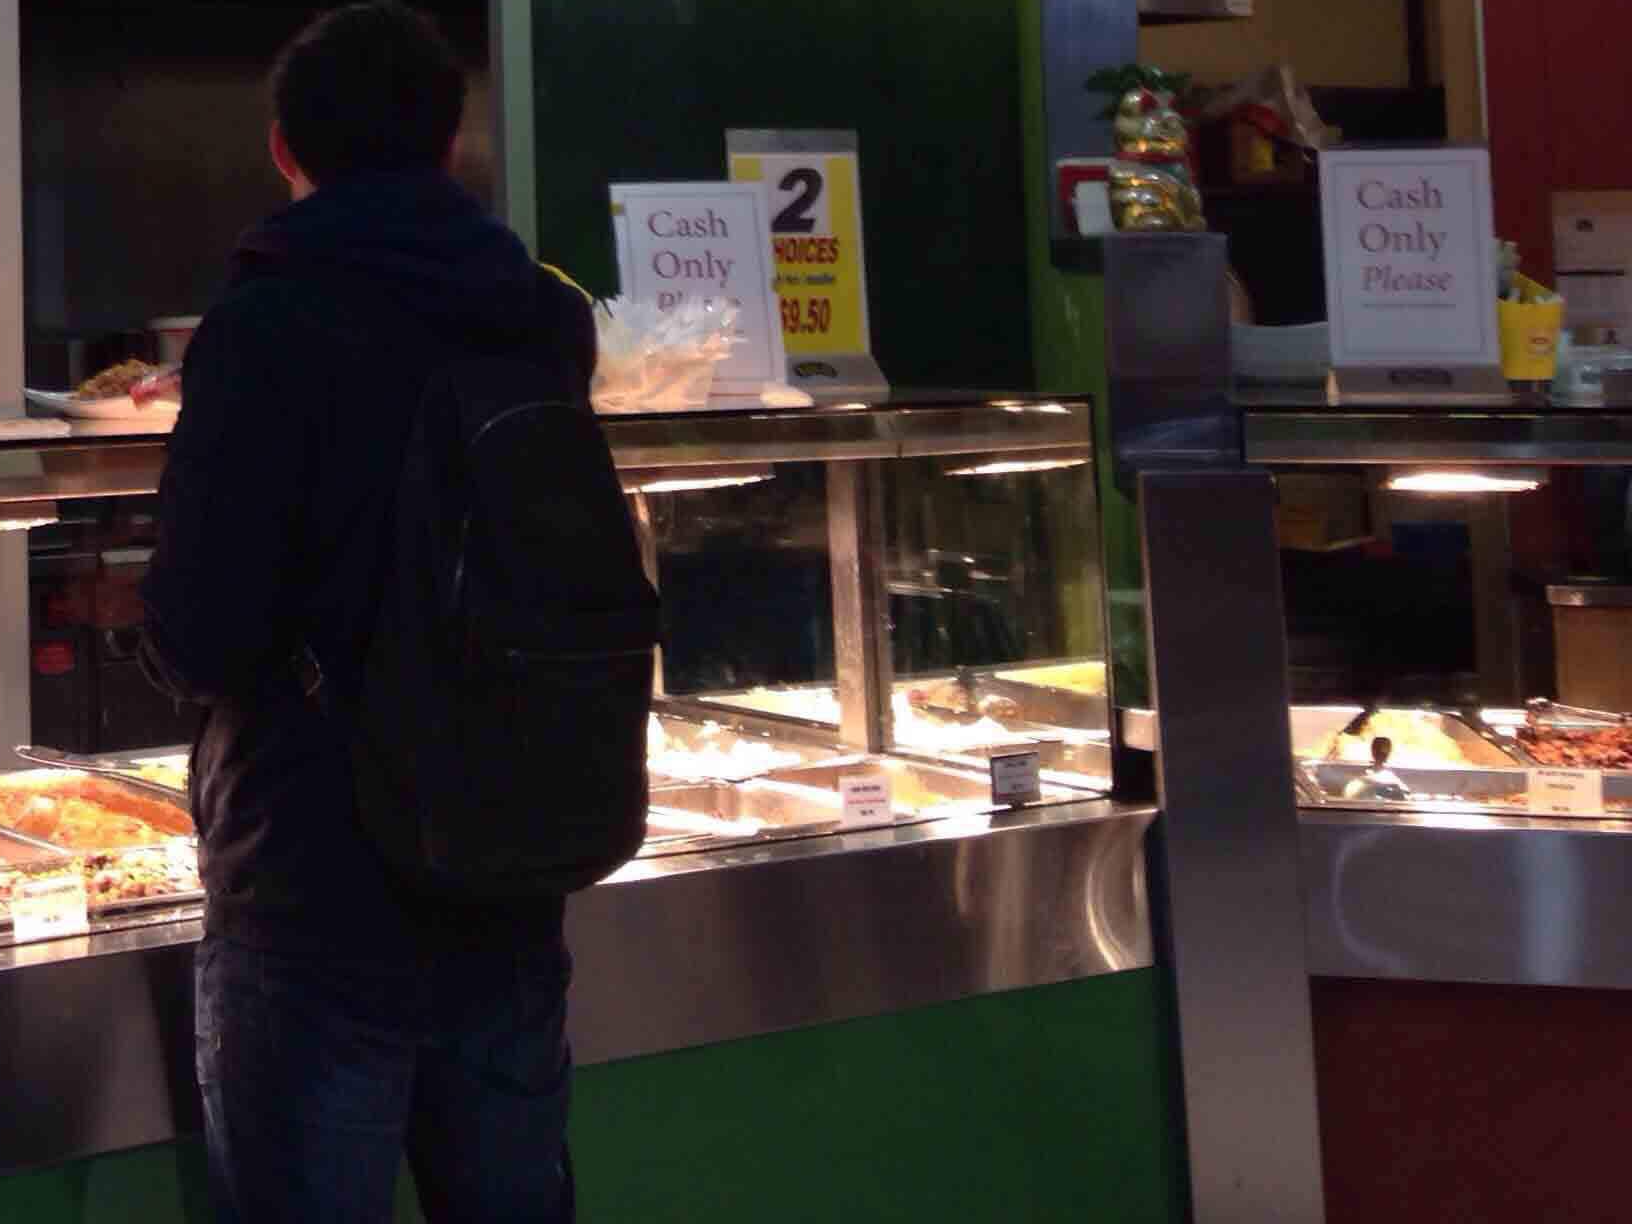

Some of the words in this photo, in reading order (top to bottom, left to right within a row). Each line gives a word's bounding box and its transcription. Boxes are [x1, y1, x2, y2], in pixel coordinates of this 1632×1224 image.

[770, 167, 824, 233] 2
[1357, 176, 1444, 210] Cash
[648, 208, 729, 239] Cash
[1359, 222, 1448, 261] Only
[653, 248, 734, 288] Only
[1361, 264, 1452, 293] Please
